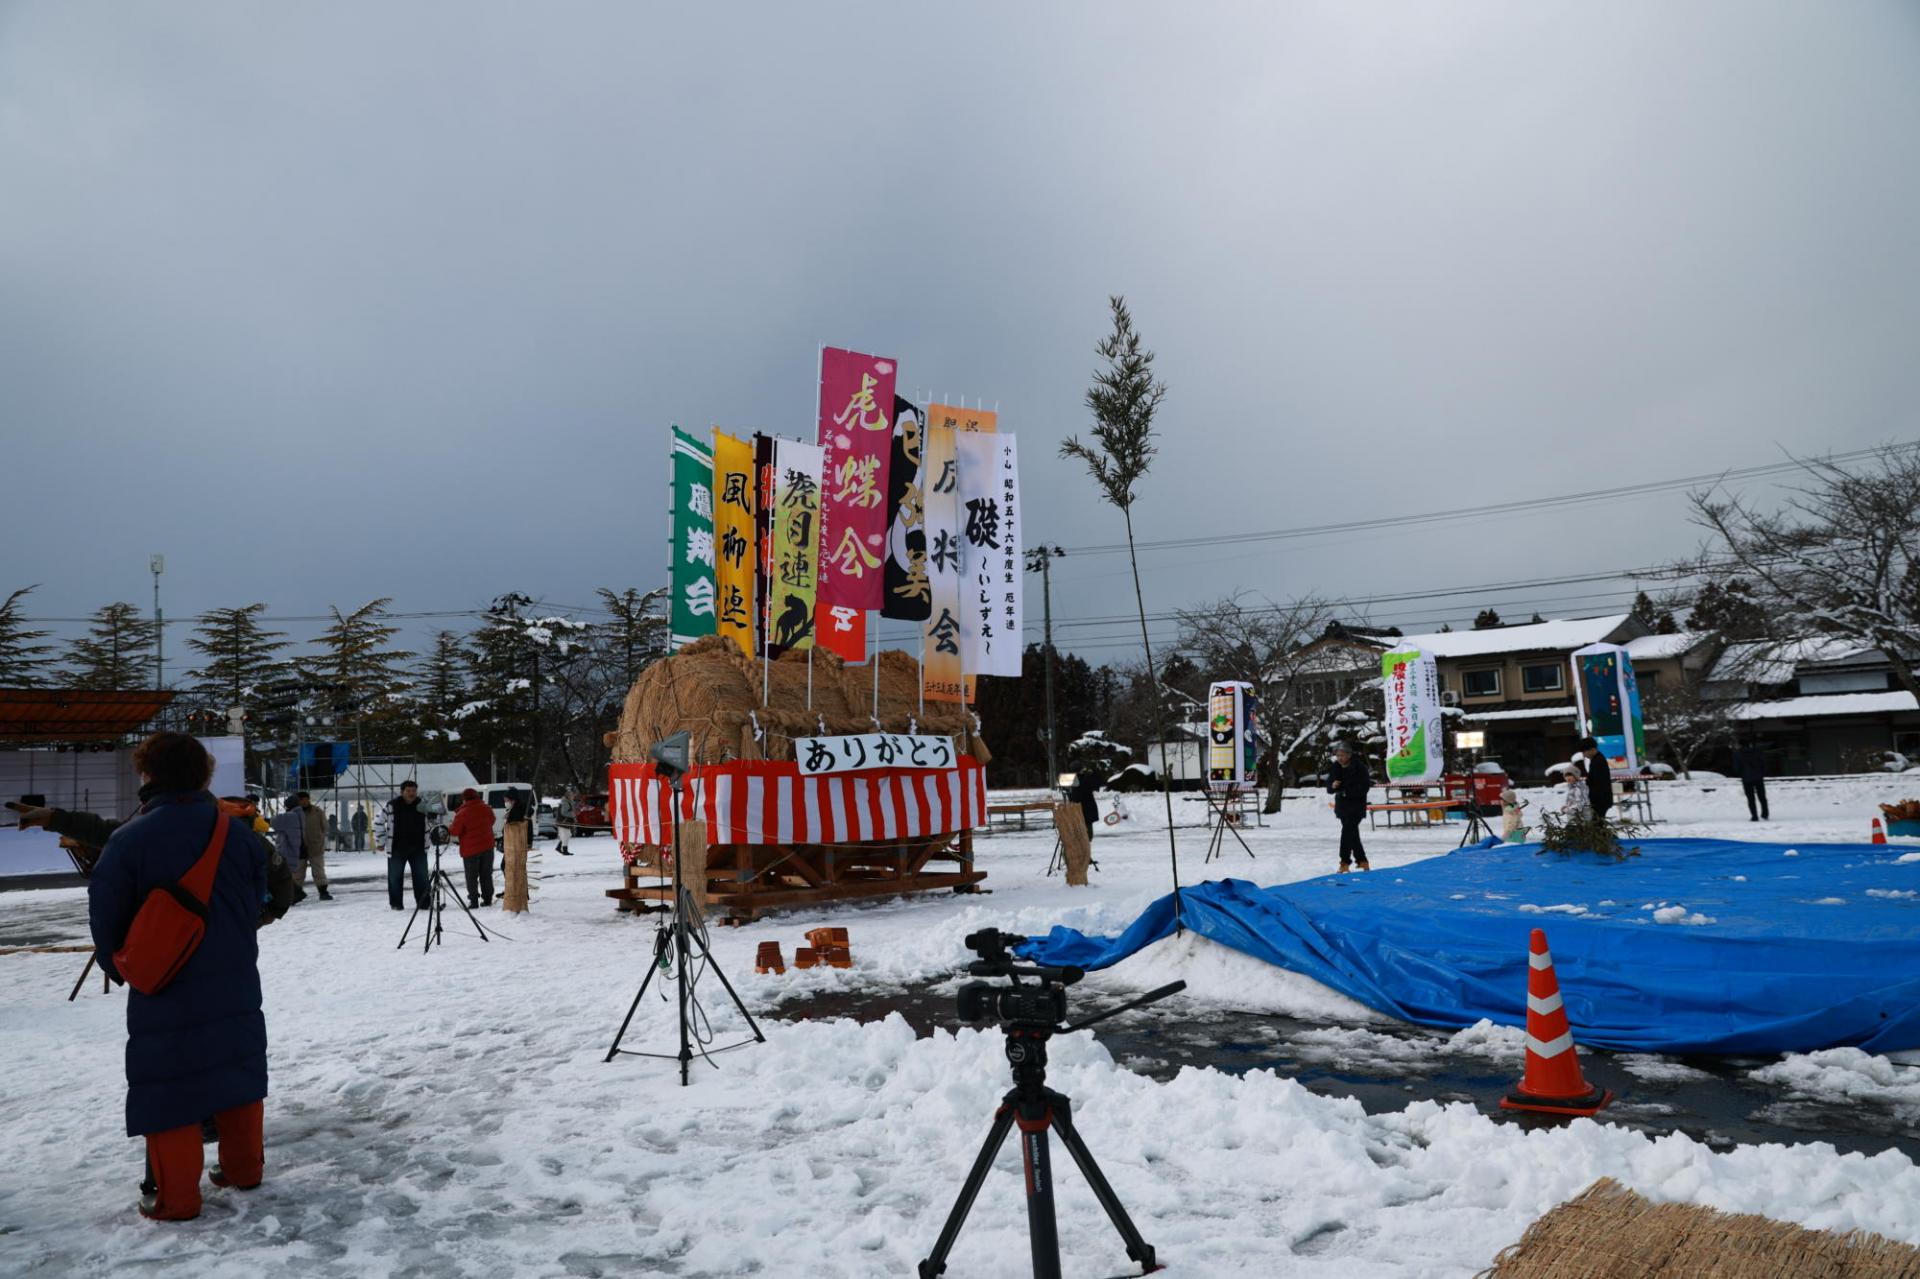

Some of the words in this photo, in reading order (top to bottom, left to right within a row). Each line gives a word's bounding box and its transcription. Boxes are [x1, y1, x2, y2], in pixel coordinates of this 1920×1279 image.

[805, 735, 950, 772] ありがとう
